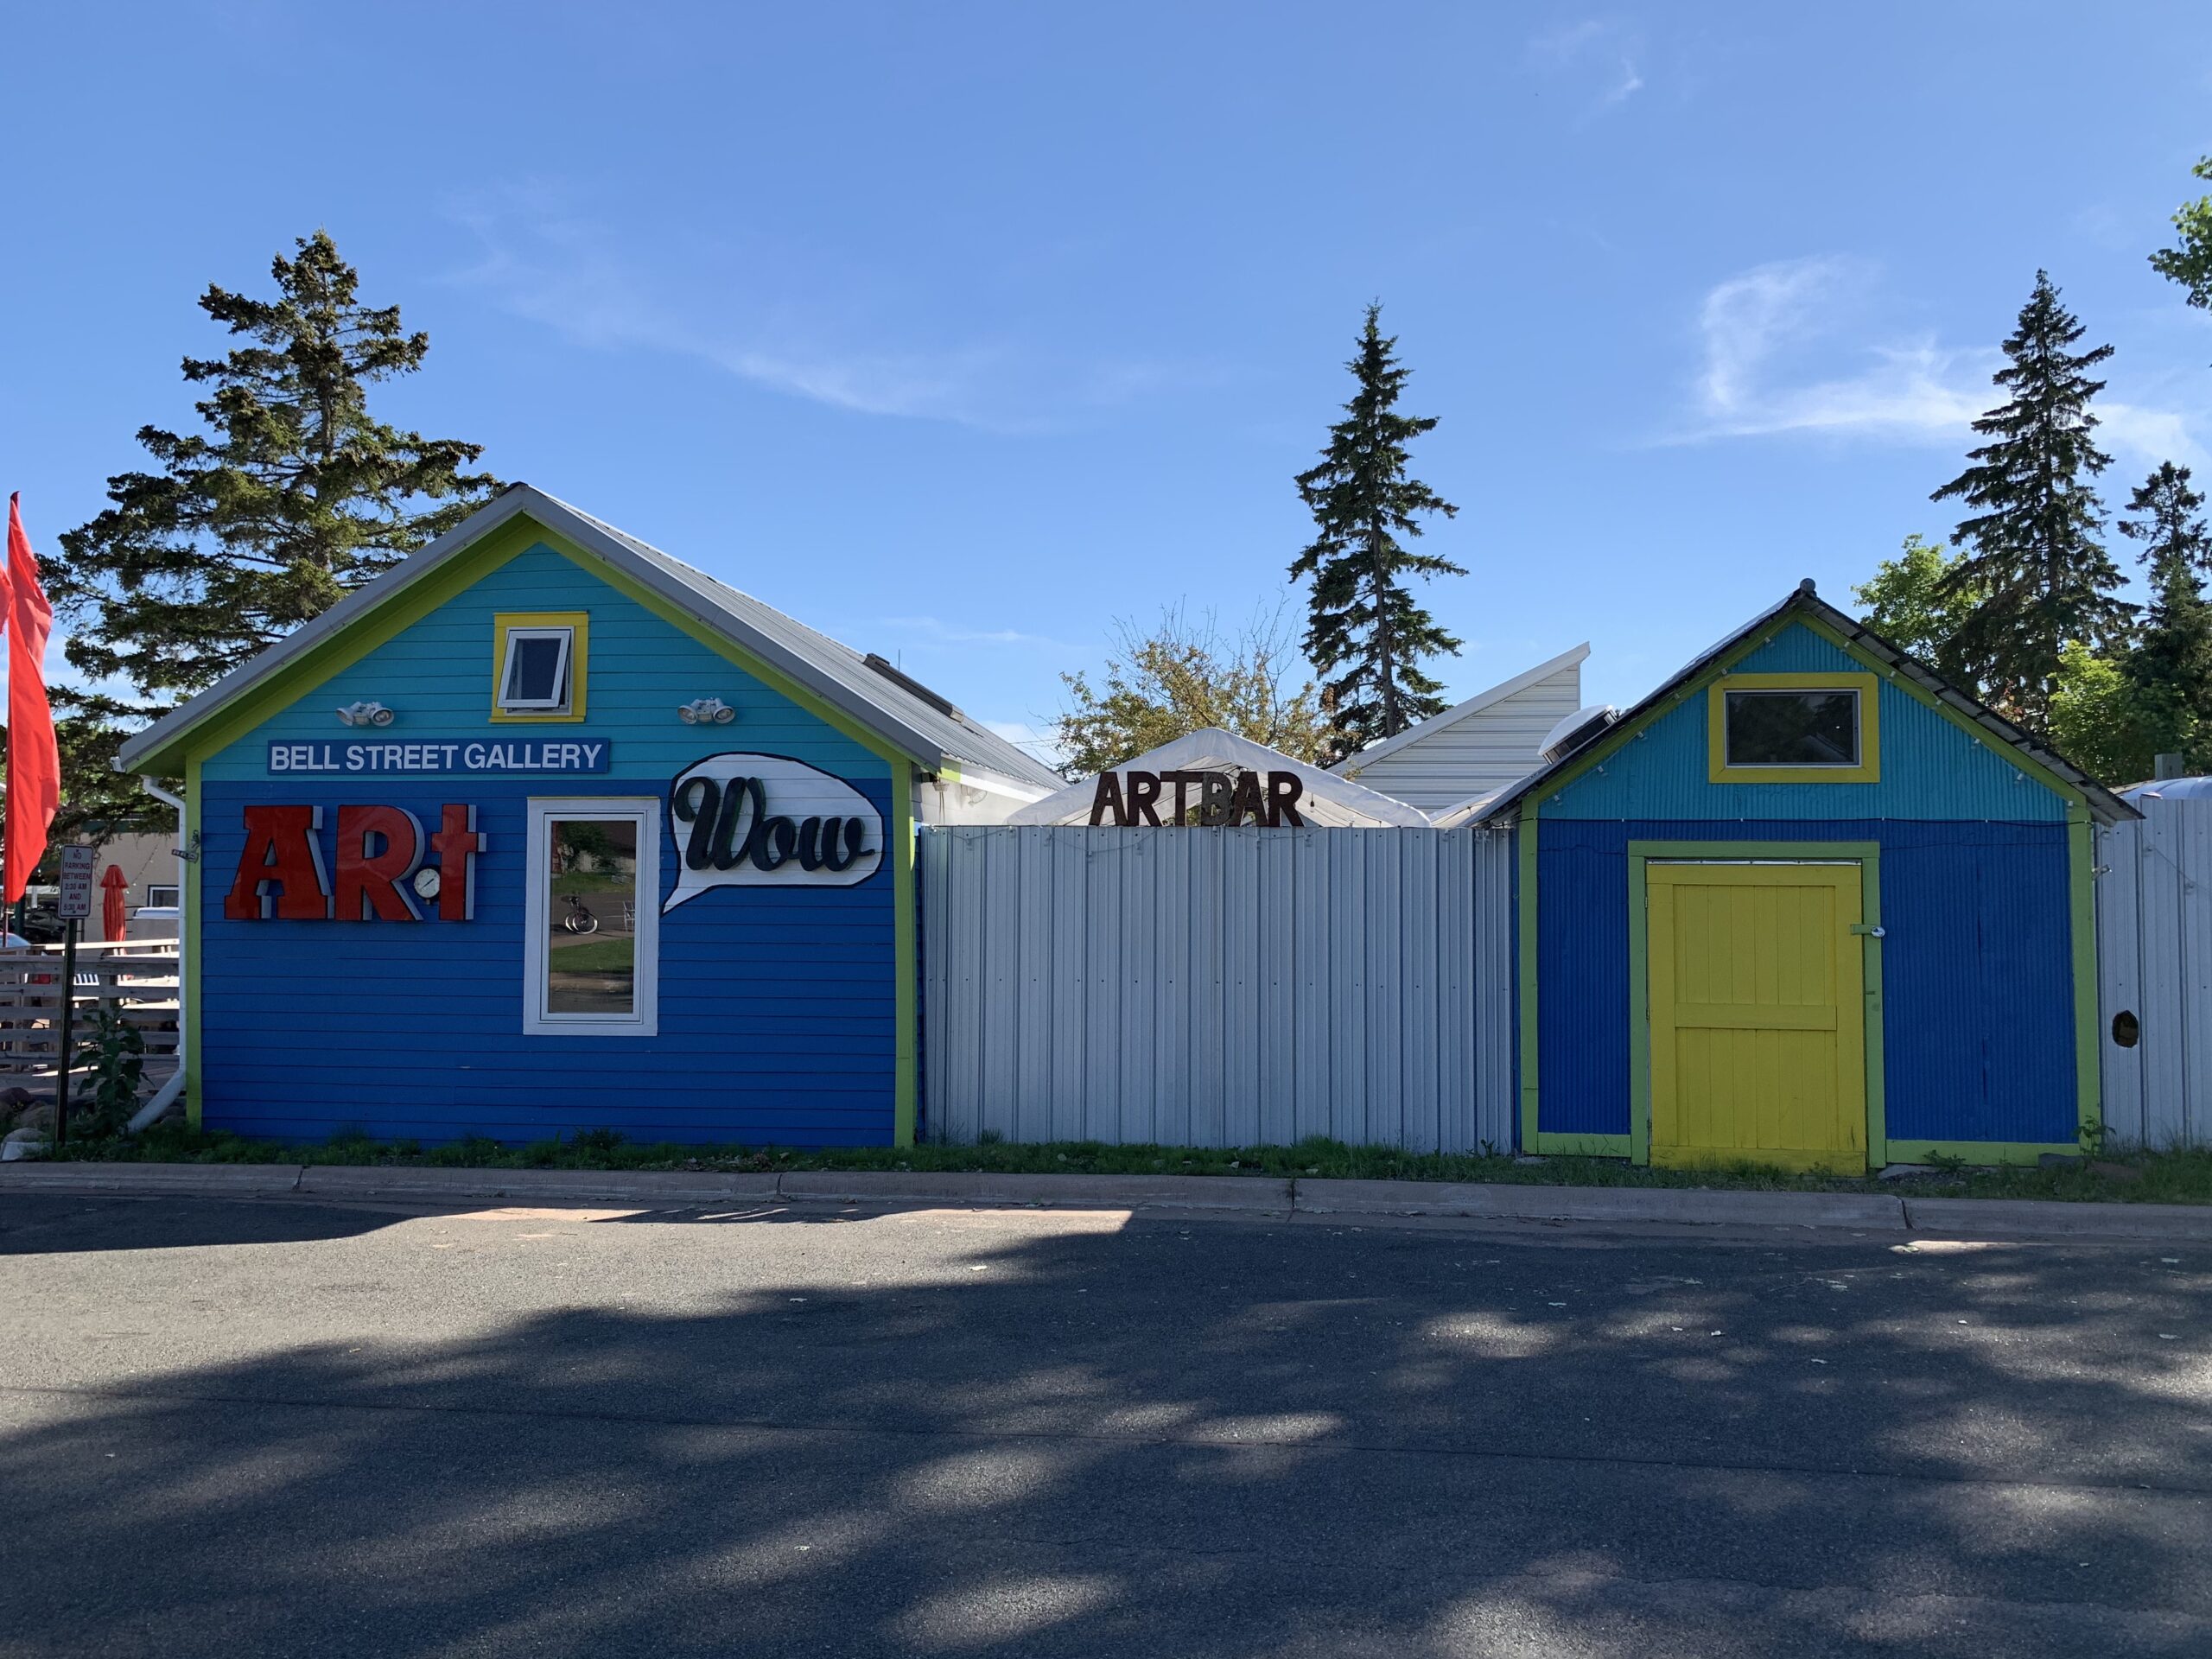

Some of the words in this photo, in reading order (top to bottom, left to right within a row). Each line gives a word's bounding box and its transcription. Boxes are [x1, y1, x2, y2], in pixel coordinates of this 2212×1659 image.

[270, 746, 340, 771] BELL
[345, 745, 459, 770] STREET
[464, 742, 602, 770] GALLERY
[673, 776, 875, 873] Wow
